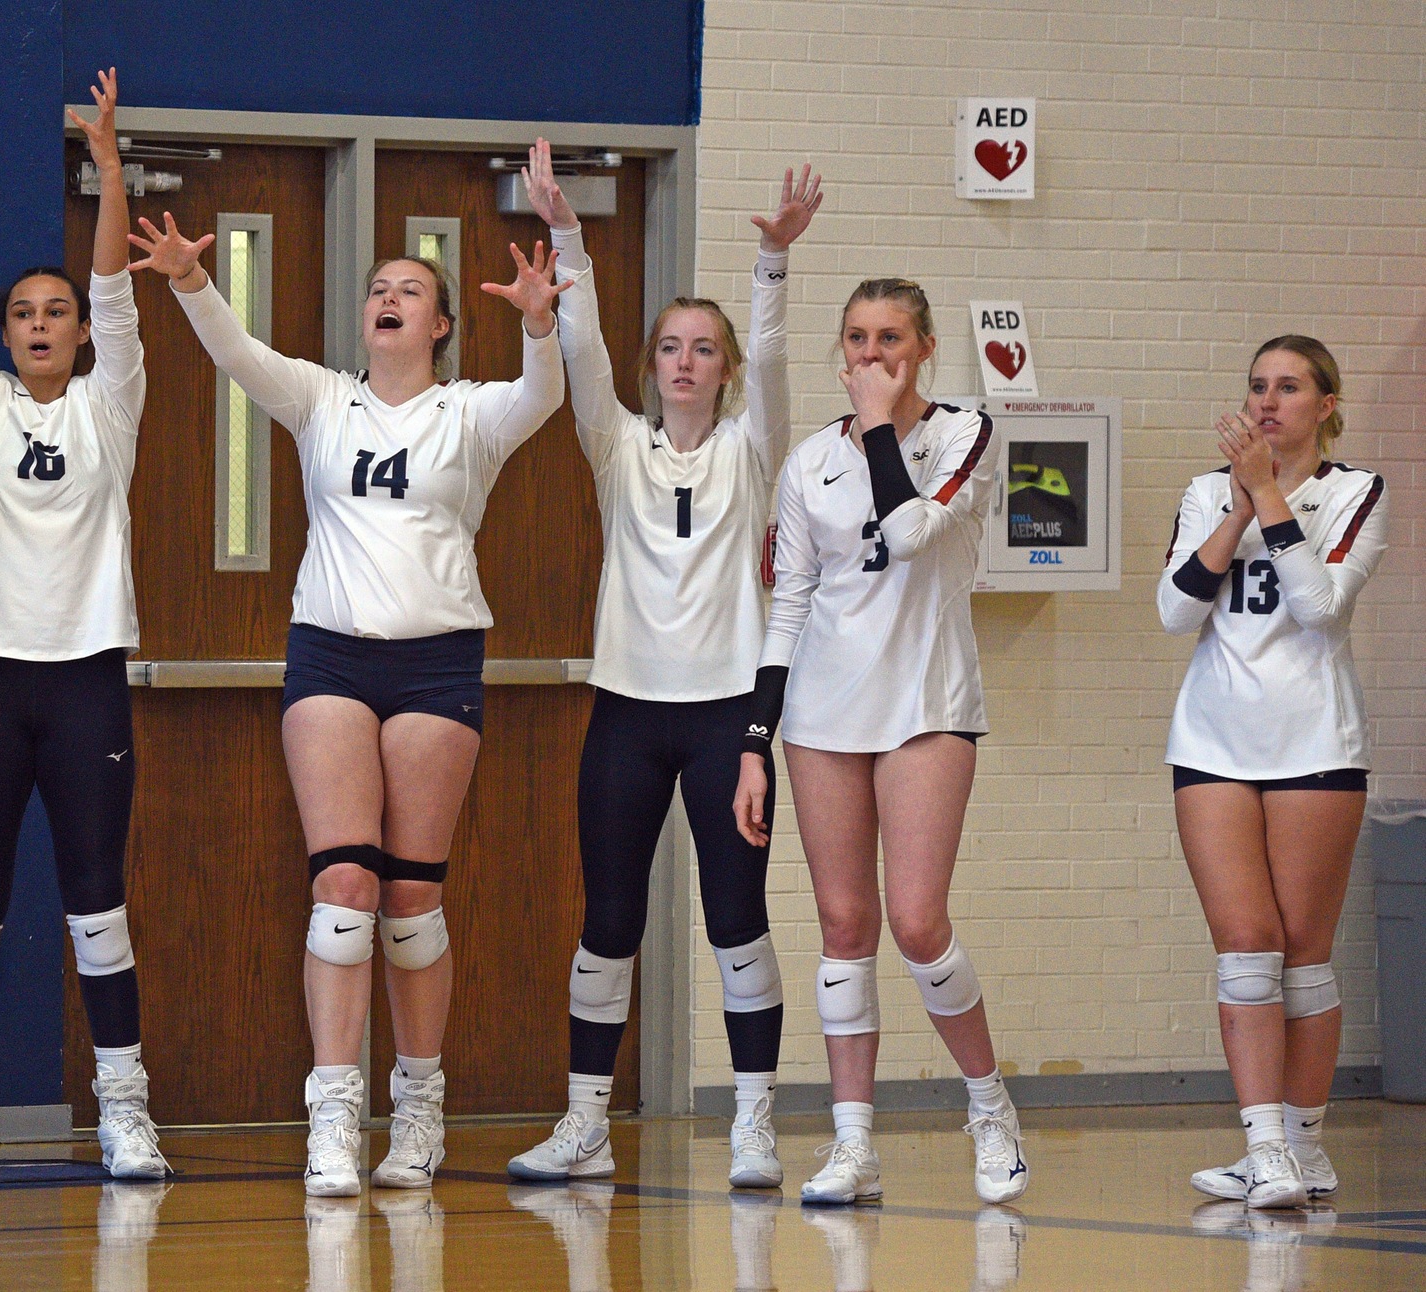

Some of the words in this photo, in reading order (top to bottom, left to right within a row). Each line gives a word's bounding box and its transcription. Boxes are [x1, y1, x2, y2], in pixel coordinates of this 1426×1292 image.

[976, 107, 1028, 127] AED
[981, 310, 1020, 330] AED
[1012, 402, 1048, 412] EMERGENCY
[1049, 402, 1095, 412] DEFIBRILLATOR
[17, 431, 65, 481] 16
[352, 448, 409, 499] 14
[675, 487, 692, 538] 1
[1011, 514, 1033, 523] ZOLL
[862, 520, 889, 572] 3
[1029, 550, 1063, 564] ZOLL
[1229, 559, 1280, 614] 13
